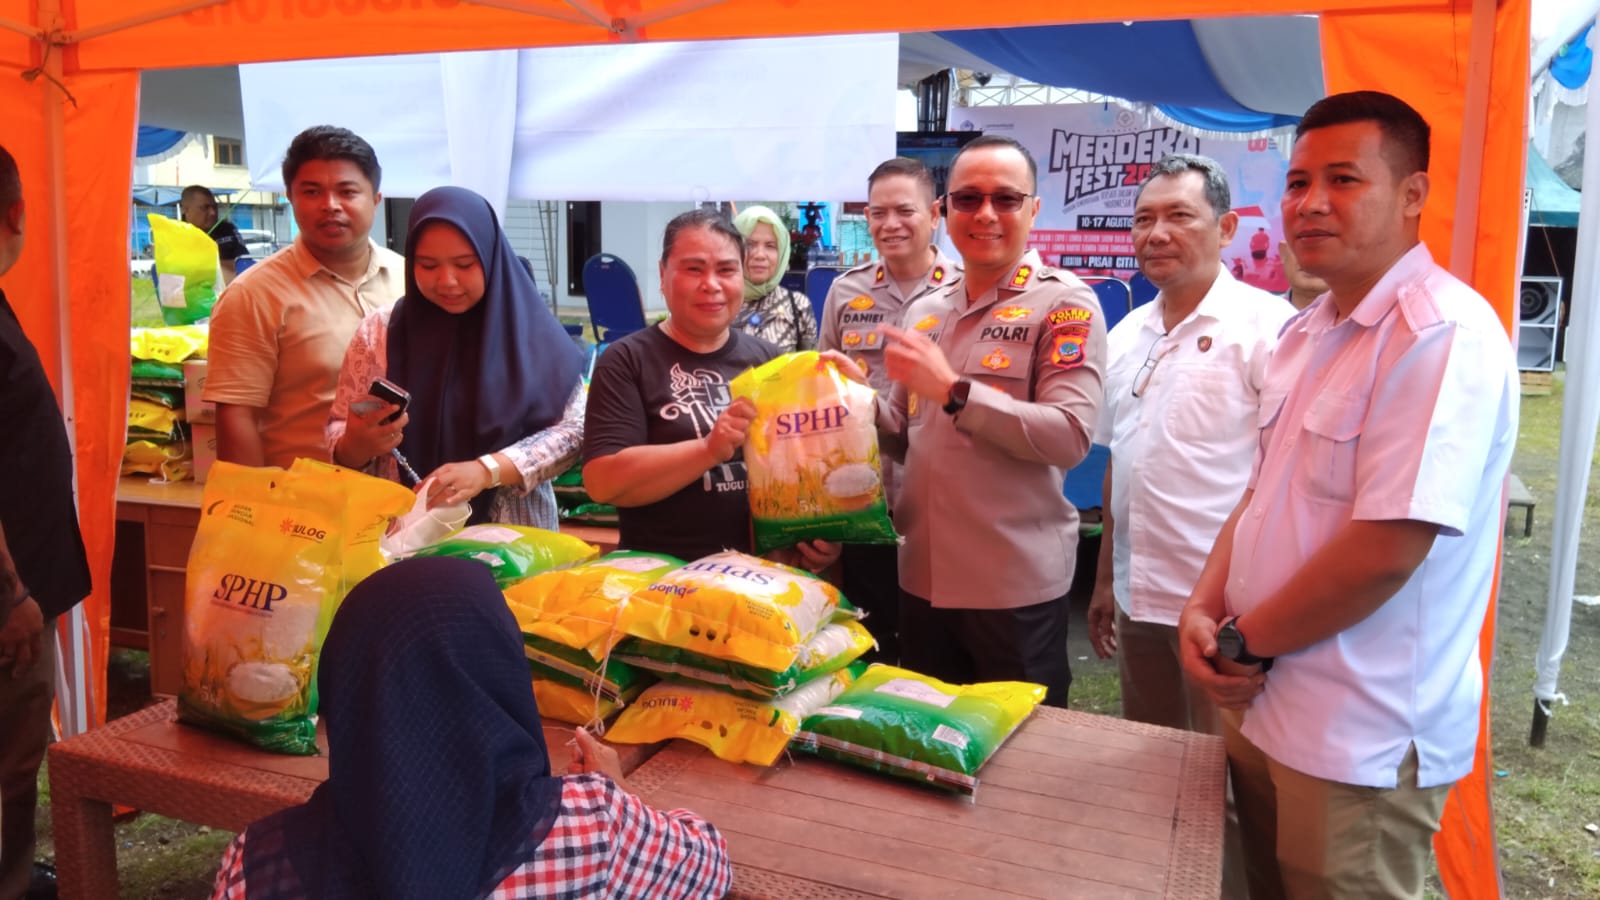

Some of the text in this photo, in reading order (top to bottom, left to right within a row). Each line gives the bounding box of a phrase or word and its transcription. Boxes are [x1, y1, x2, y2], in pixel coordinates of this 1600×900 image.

[1049, 127, 1200, 172] MERDEKA
[1065, 165, 1123, 206] FEST
[980, 326, 1029, 342] POLRI
[775, 405, 849, 437] SPHP
[716, 481, 744, 492] TUGU
[213, 573, 288, 612] SPHP
